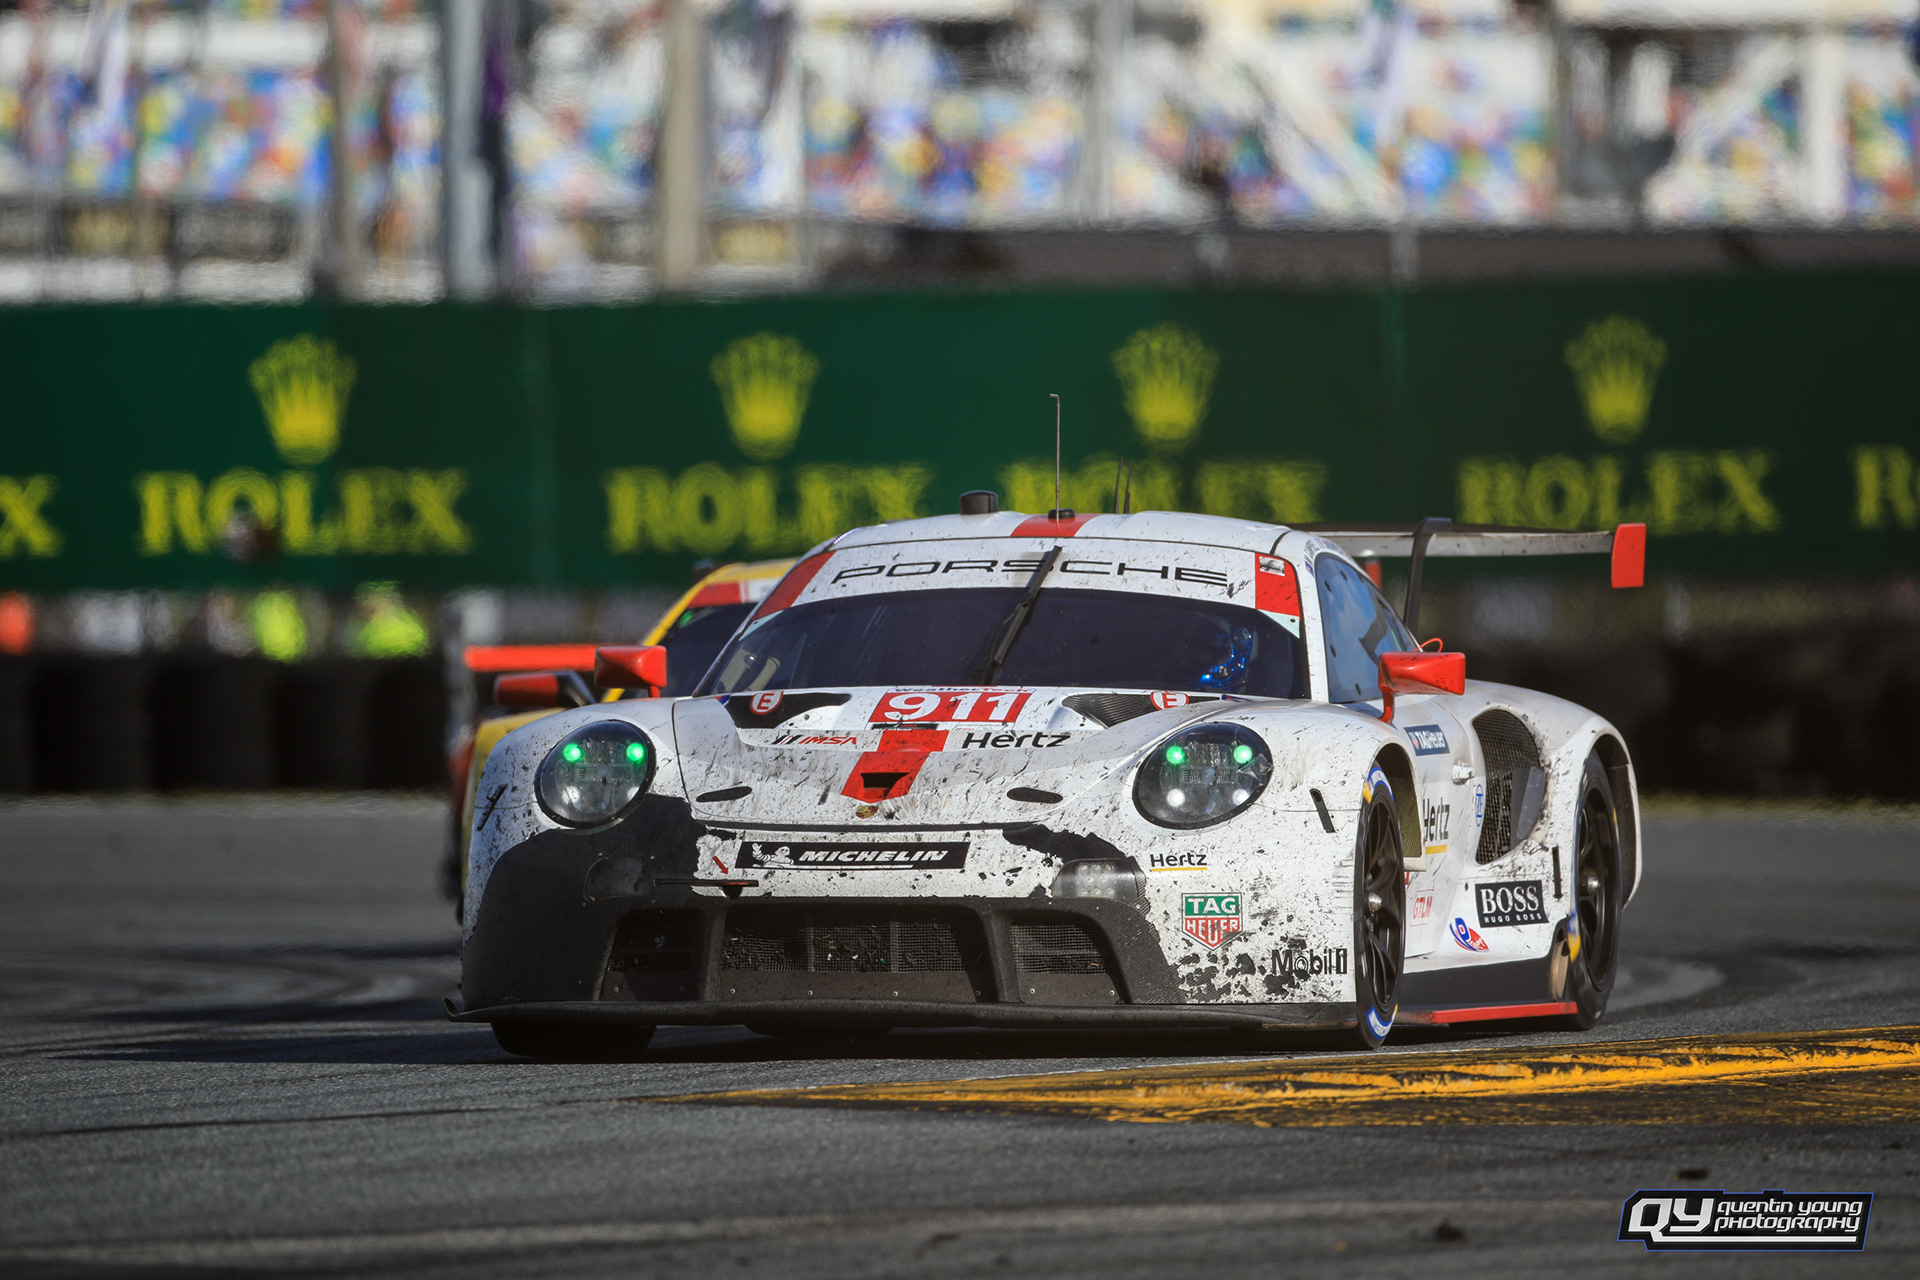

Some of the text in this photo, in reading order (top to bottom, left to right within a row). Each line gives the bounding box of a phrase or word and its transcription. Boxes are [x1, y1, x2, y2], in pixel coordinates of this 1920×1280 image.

[1458, 447, 1780, 535] ROLEX
[133, 468, 471, 557] ROLEX
[604, 462, 932, 554] ROLEX
[831, 559, 1228, 588] PORSCHE
[756, 692, 775, 710] E
[884, 692, 1020, 721] 911
[1162, 692, 1179, 709] E
[798, 736, 857, 745] IMSA
[962, 731, 1071, 749] Hertz
[1422, 797, 1450, 841] Hertz
[799, 850, 949, 863] MICHELIN
[1151, 852, 1208, 868] Hertz
[1188, 896, 1237, 915] TAG
[1412, 895, 1434, 920] GTLM
[1480, 885, 1539, 914] BOSS
[1186, 917, 1240, 943] HEUER
[1484, 912, 1542, 924] HUGO BOSS
[1271, 948, 1332, 975] Mobil
